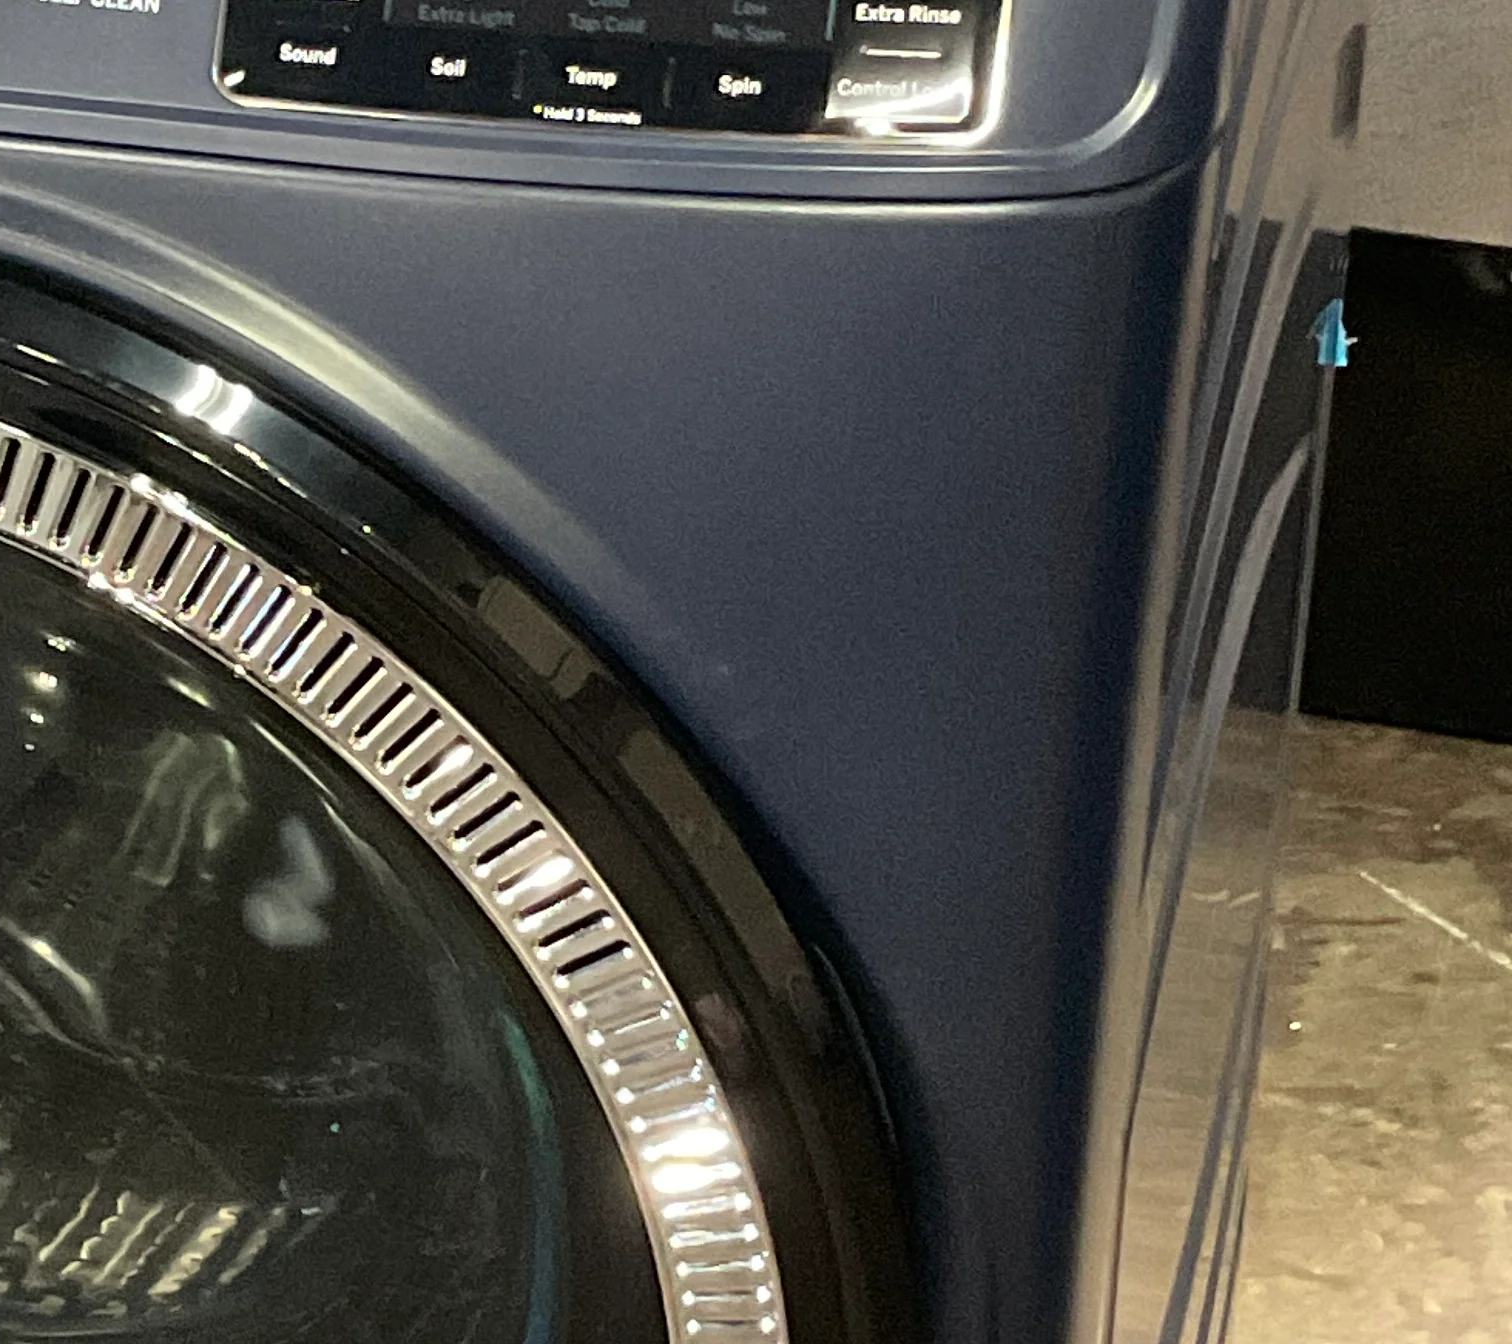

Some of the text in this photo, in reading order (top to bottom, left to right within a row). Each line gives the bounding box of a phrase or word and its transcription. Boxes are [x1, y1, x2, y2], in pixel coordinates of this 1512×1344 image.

[854, 3, 963, 26] Extra Rinse
[278, 42, 338, 67] Sound
[429, 56, 467, 78] Soil
[565, 64, 618, 91] Temp
[717, 73, 762, 97] Spin
[836, 77, 907, 97] Control
[575, 107, 585, 122] 3
